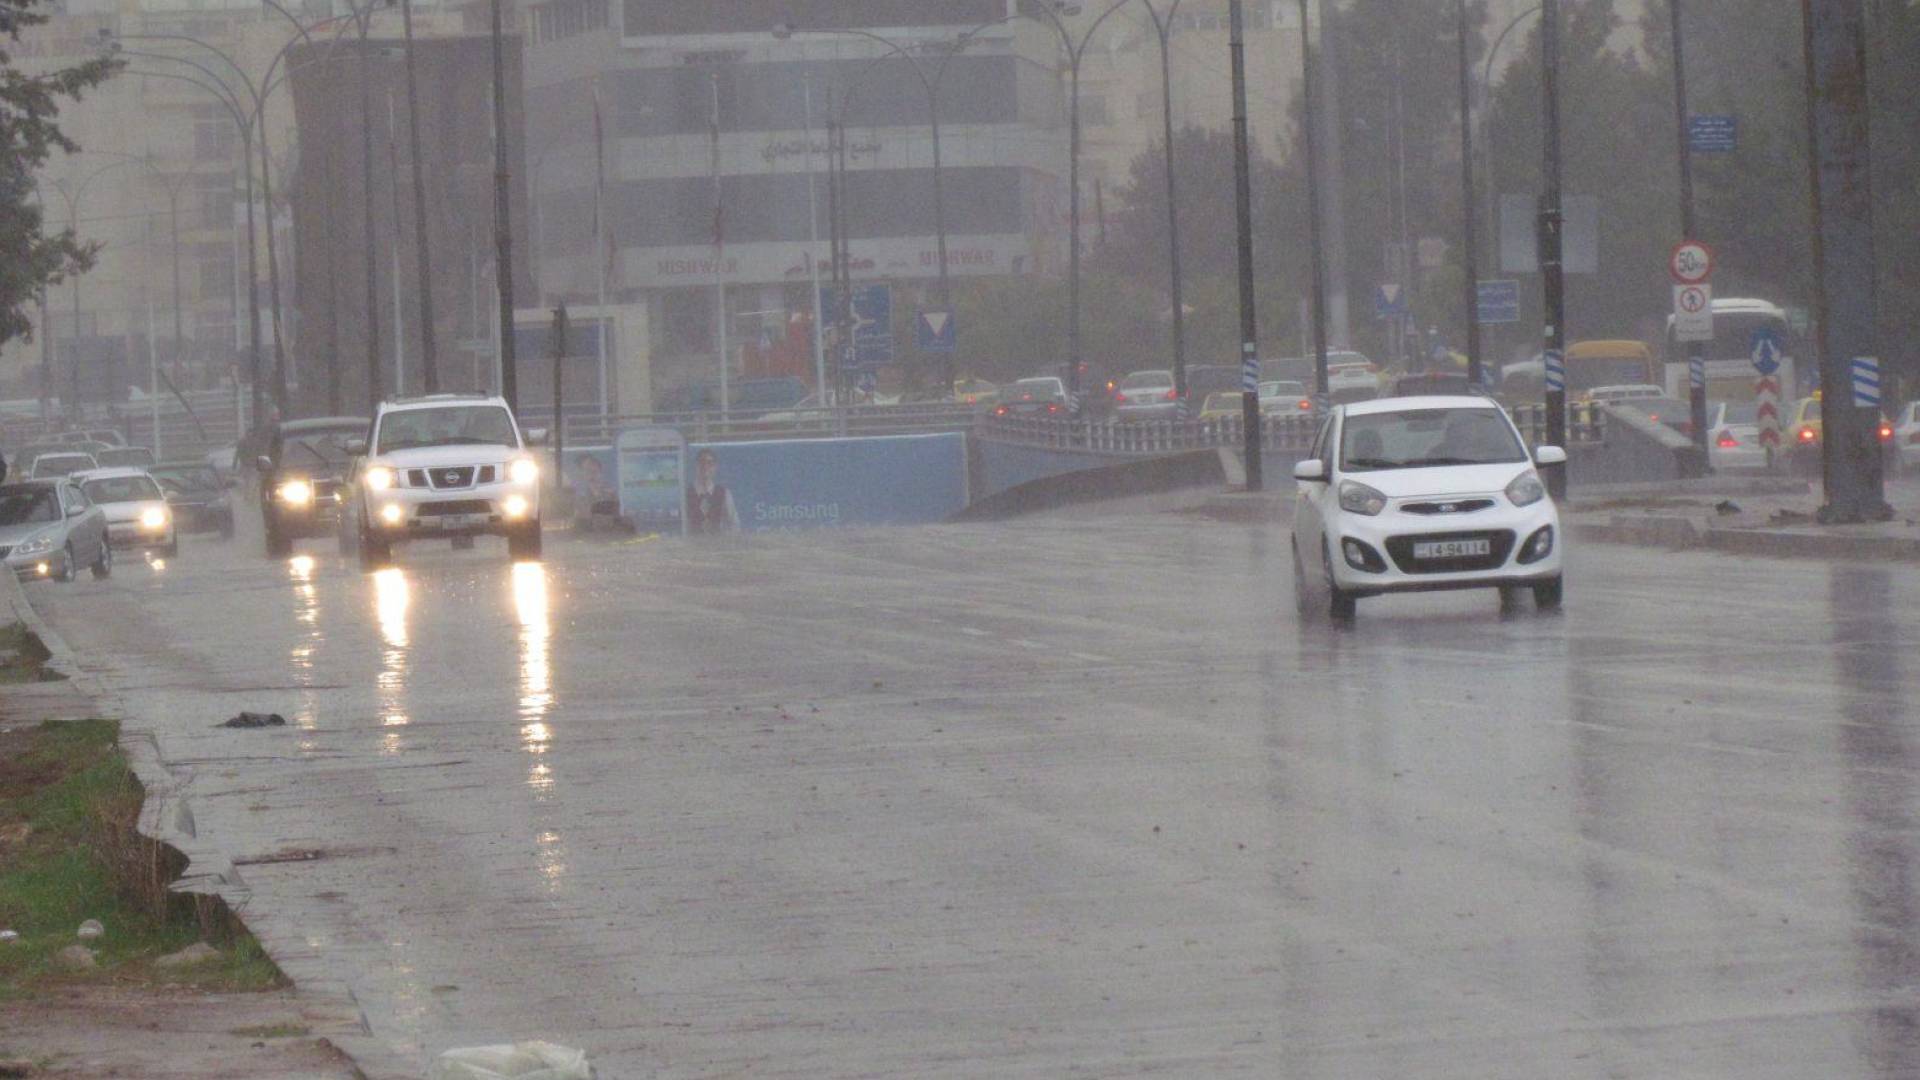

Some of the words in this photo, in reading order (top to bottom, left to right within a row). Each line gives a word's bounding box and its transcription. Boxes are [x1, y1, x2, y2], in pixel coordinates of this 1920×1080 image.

[918, 247, 995, 266] MIHWAR
[1679, 251, 1695, 273] 50
[755, 501, 839, 521] Samsung
